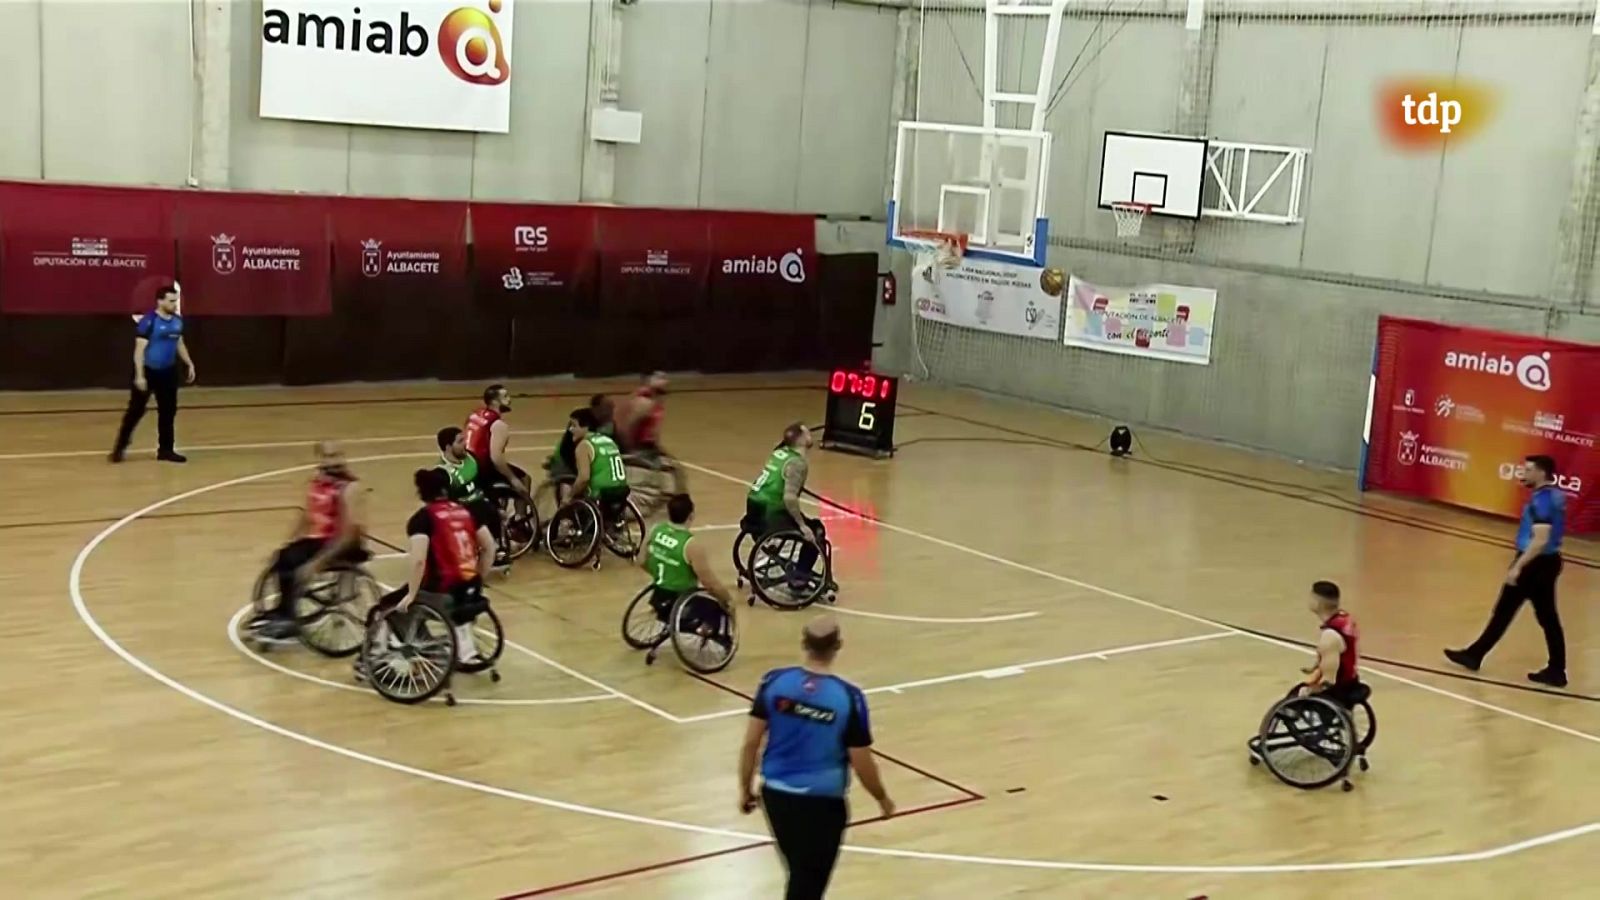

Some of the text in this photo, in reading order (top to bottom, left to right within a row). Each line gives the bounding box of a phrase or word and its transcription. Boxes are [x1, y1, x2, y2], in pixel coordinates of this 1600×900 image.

[263, 7, 430, 57] amiab
[515, 226, 548, 245] res
[242, 246, 300, 256] Ayuntamiento
[387, 250, 440, 260] Ayuntamiento
[33, 256, 147, 268] DIPUTACIÓN DE ALBACETE
[243, 258, 300, 270] ALBACETE
[387, 262, 440, 273] ALBACETE
[722, 255, 778, 274] amiab
[1445, 351, 1514, 376] amiab
[831, 370, 889, 399] 07:31
[858, 401, 876, 430] 6
[610, 456, 626, 481] 10
[656, 562, 664, 584] 1
